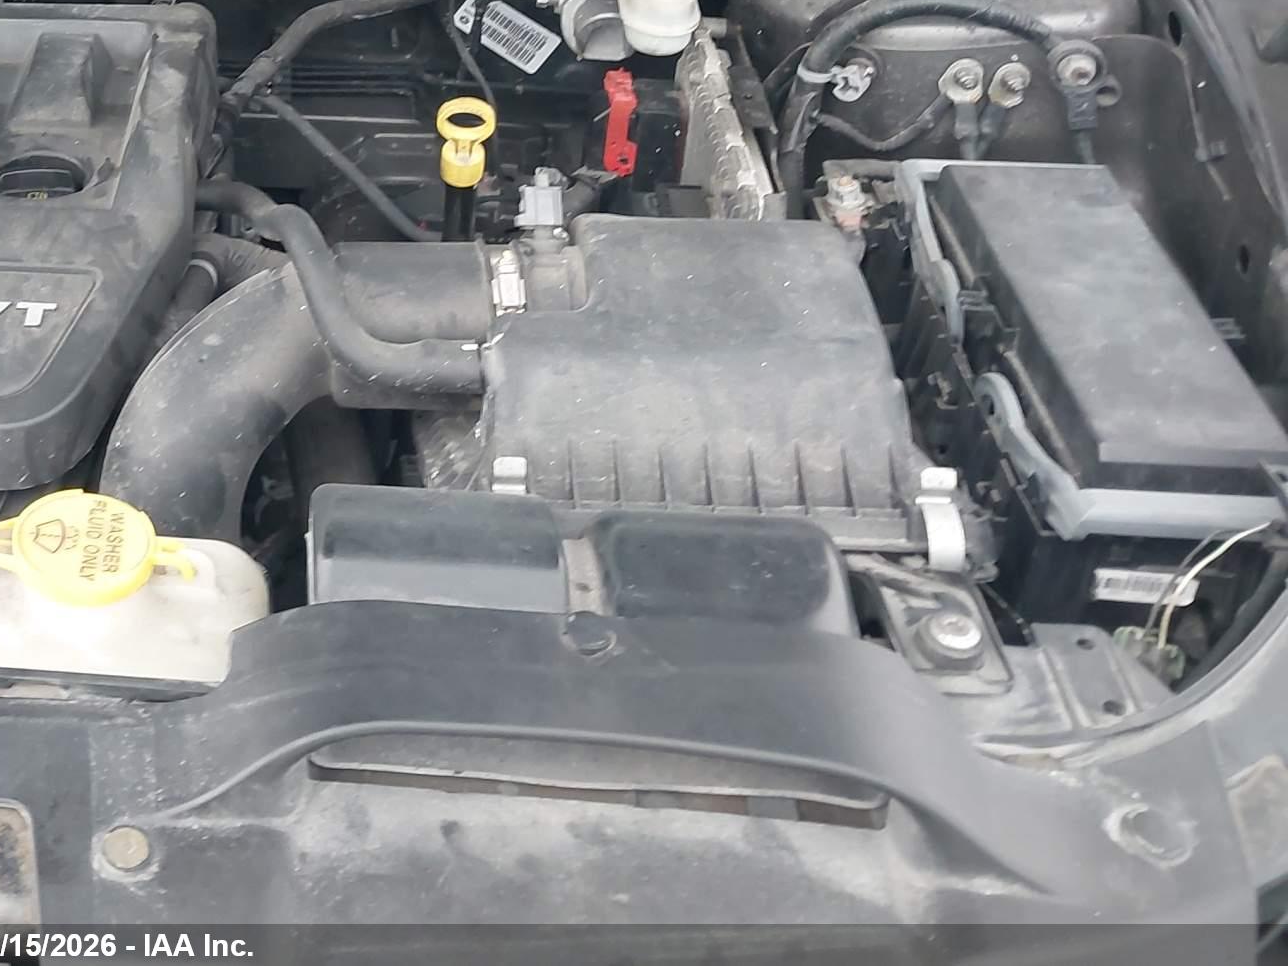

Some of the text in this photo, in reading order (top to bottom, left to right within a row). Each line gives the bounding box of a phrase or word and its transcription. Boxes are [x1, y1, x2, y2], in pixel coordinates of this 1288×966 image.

[79, 500, 107, 581] FLUID ONLY
[102, 512, 125, 573] WASHER
